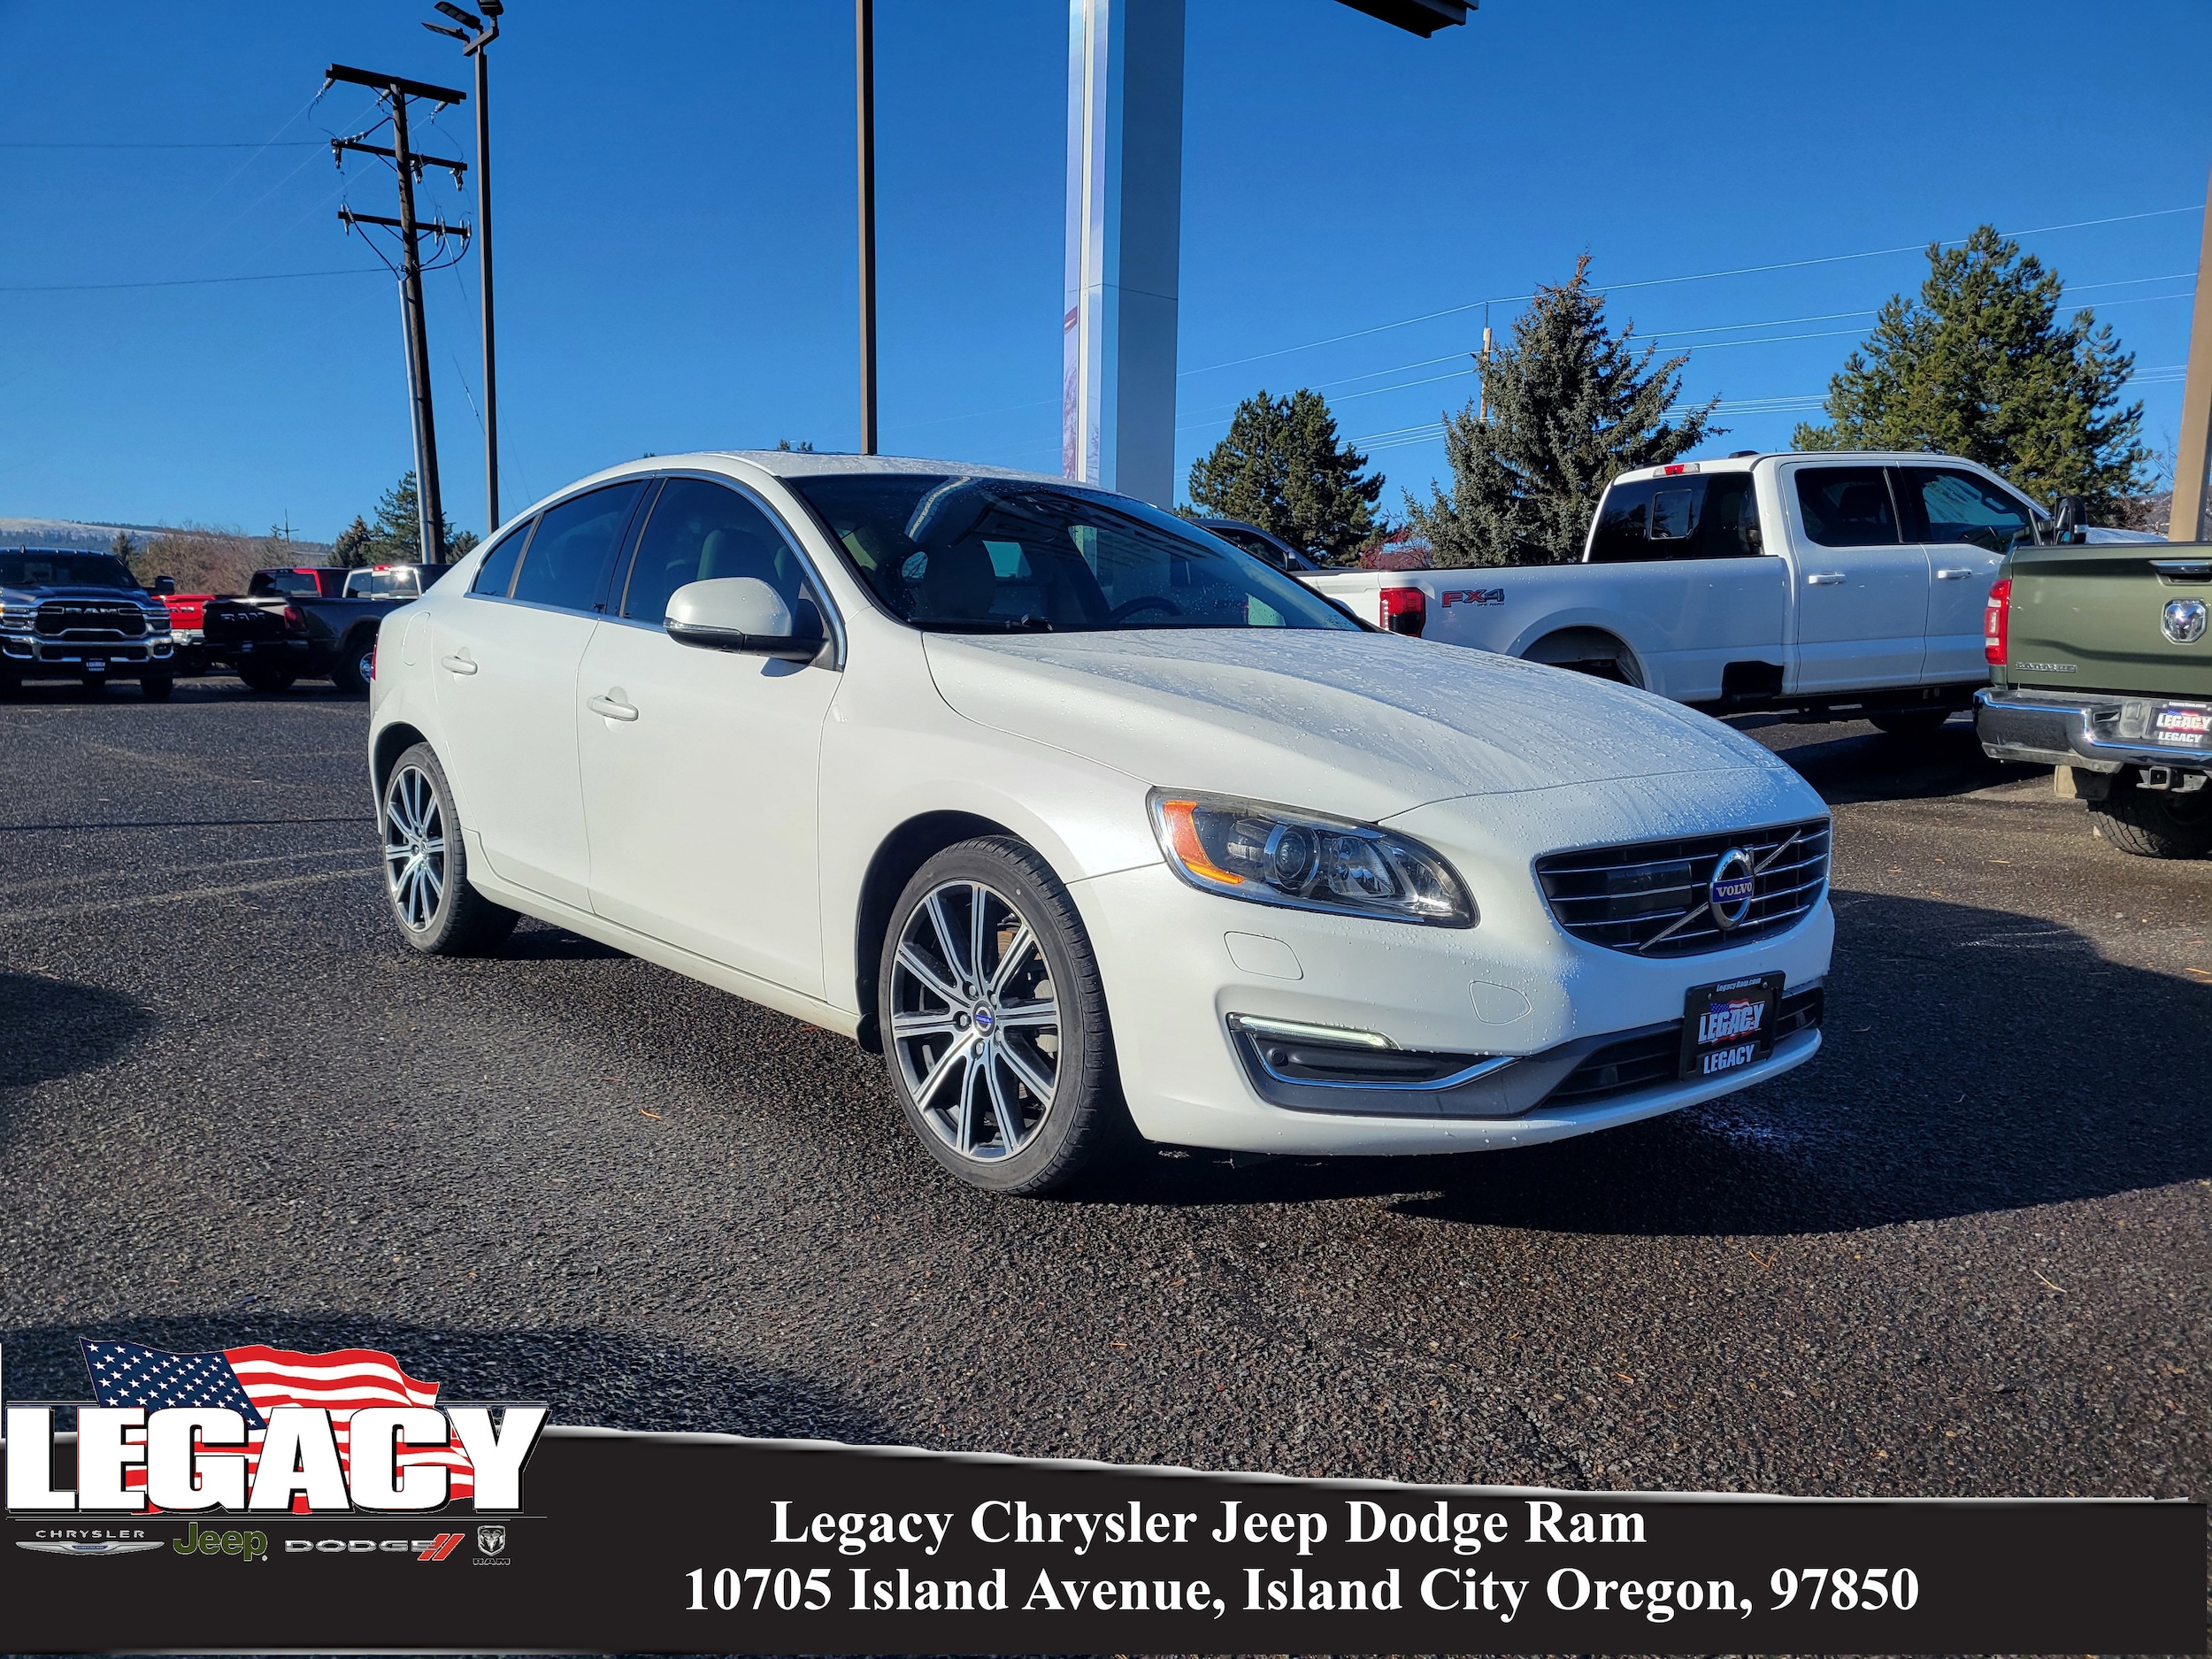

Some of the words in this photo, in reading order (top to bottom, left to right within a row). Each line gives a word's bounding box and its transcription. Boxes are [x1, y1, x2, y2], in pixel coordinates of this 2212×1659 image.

[1441, 588, 1505, 608] FX4
[2156, 713, 2212, 729] LEGACY
[2158, 731, 2202, 742] LEGACY
[1716, 882, 1753, 897] VOLVO
[1698, 1003, 1764, 1042] LEGACY
[1703, 1044, 1755, 1074] LEGACY
